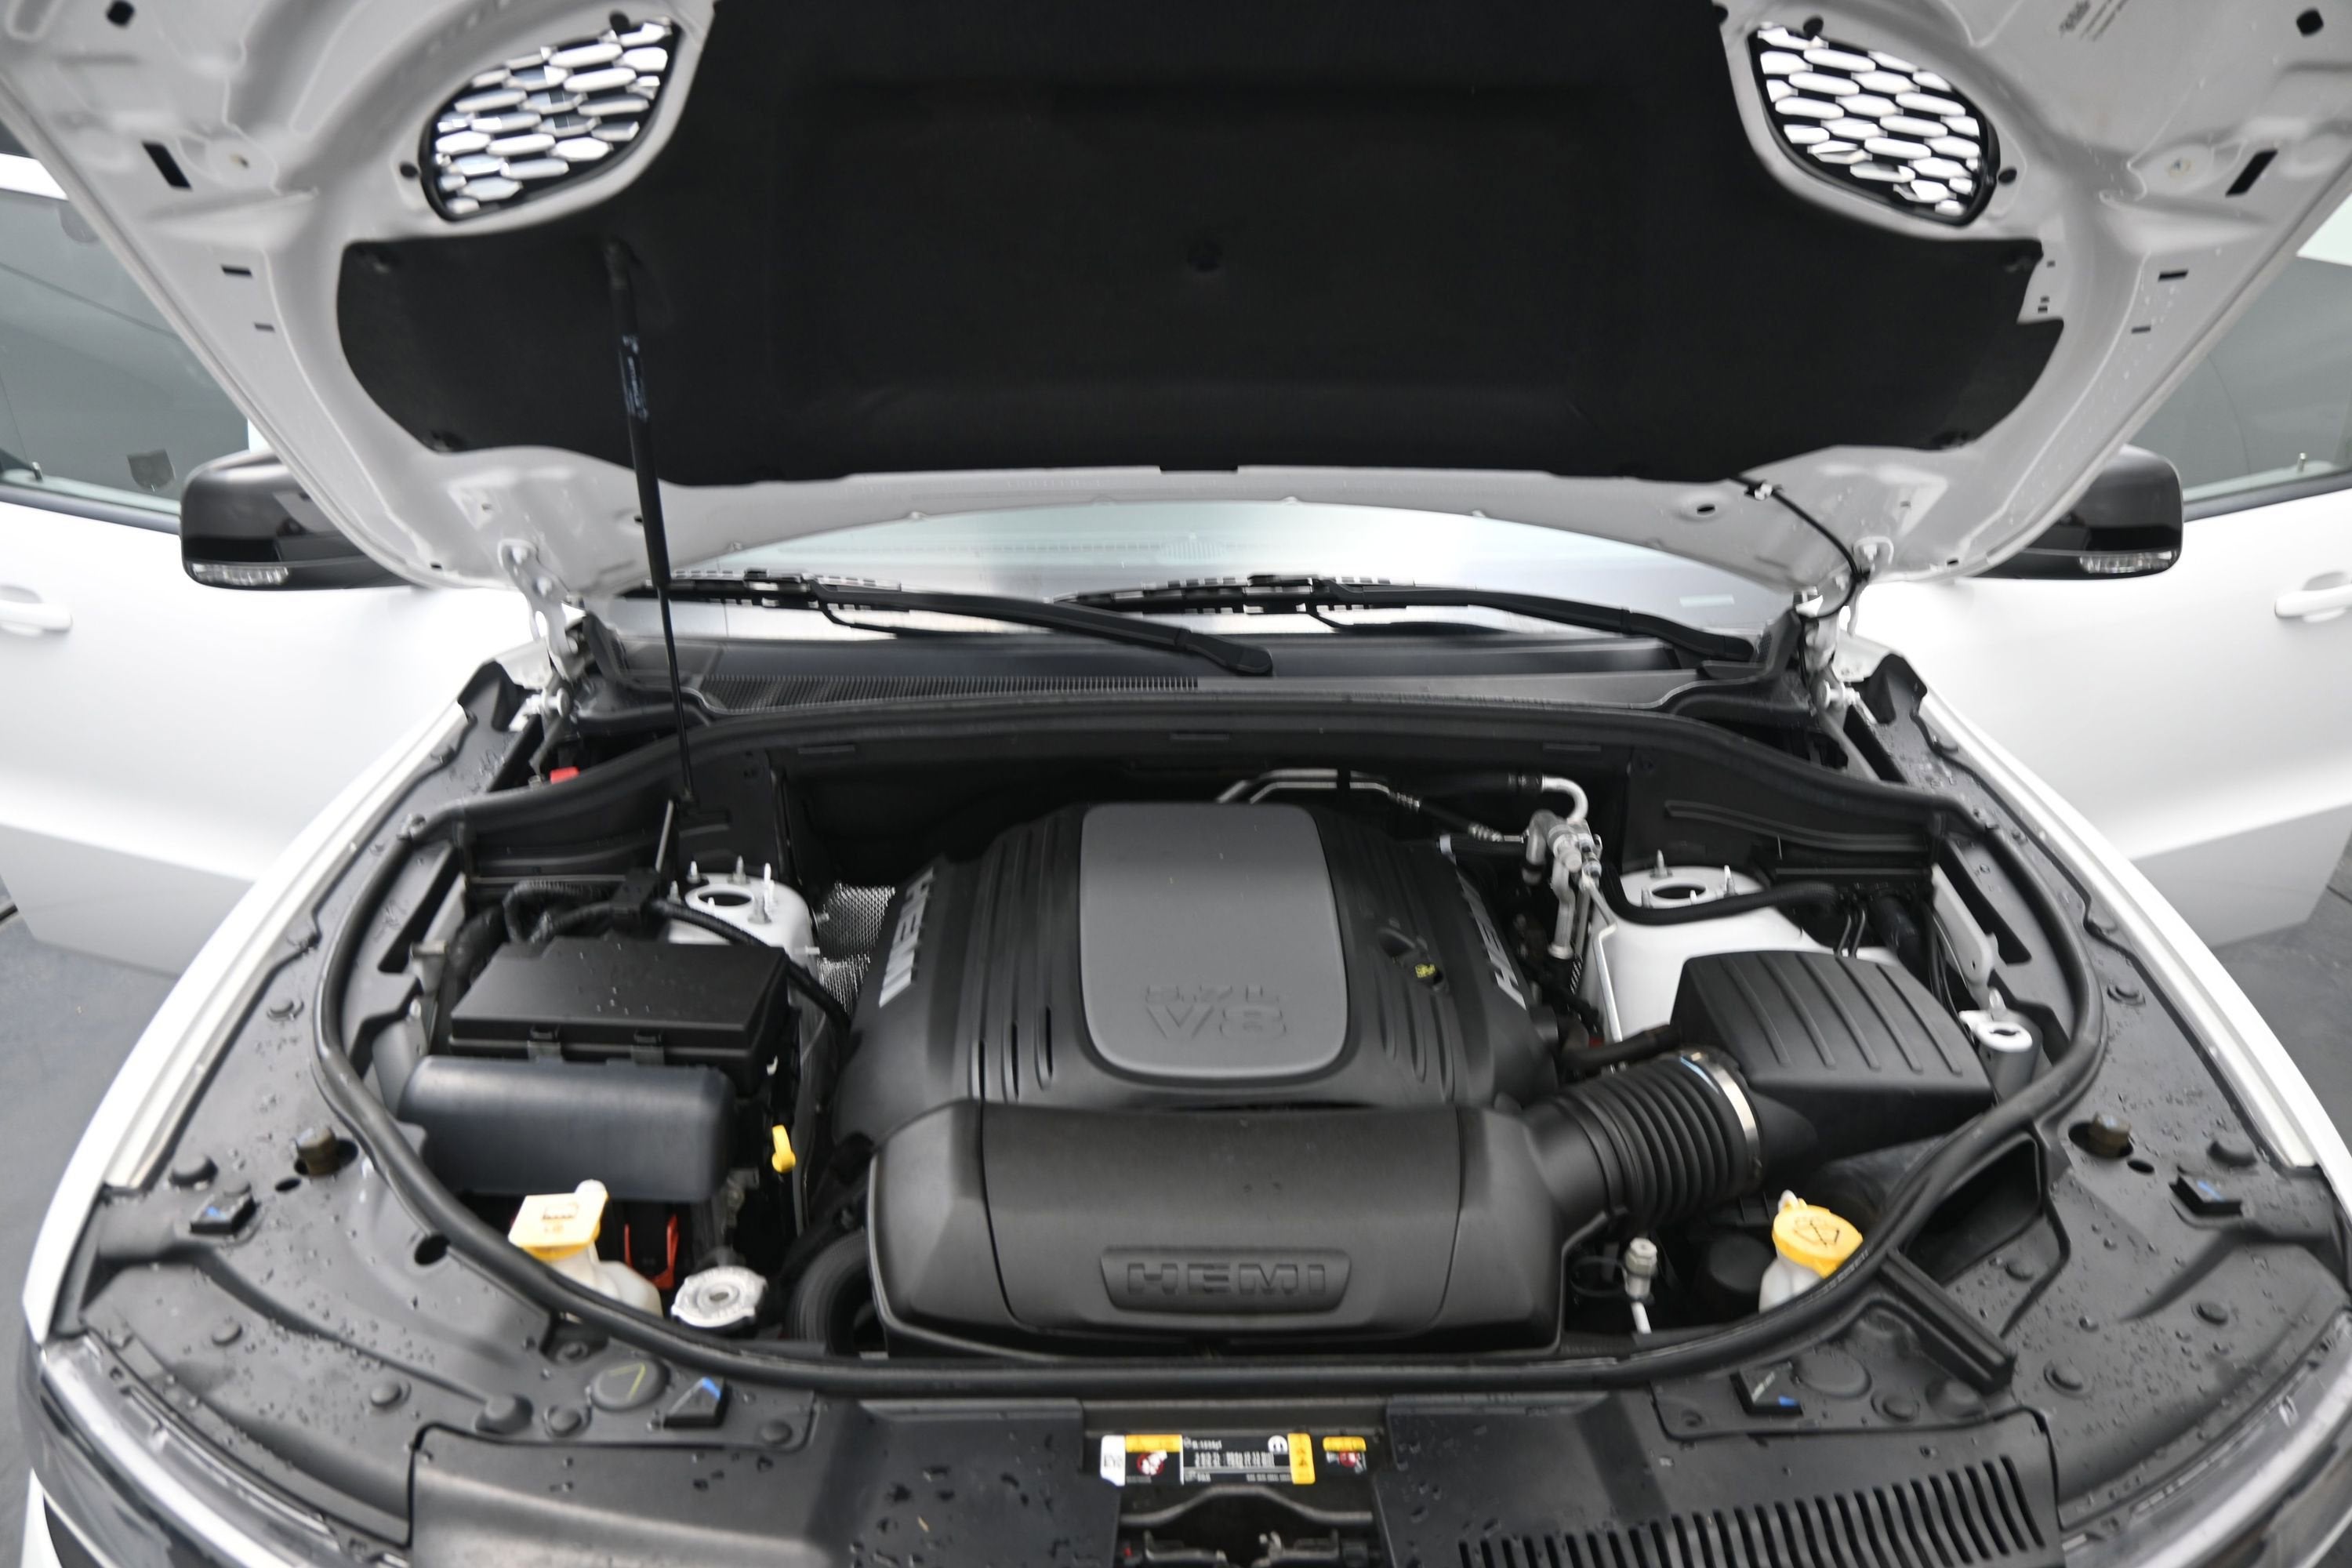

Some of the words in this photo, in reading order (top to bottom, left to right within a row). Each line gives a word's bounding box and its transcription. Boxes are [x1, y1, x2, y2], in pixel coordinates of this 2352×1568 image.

[879, 866, 935, 1008] HEMI
[1456, 869, 1527, 1011] HEMI
[1145, 1004, 1287, 1041] V8
[1127, 1262, 1327, 1295] HEMI
